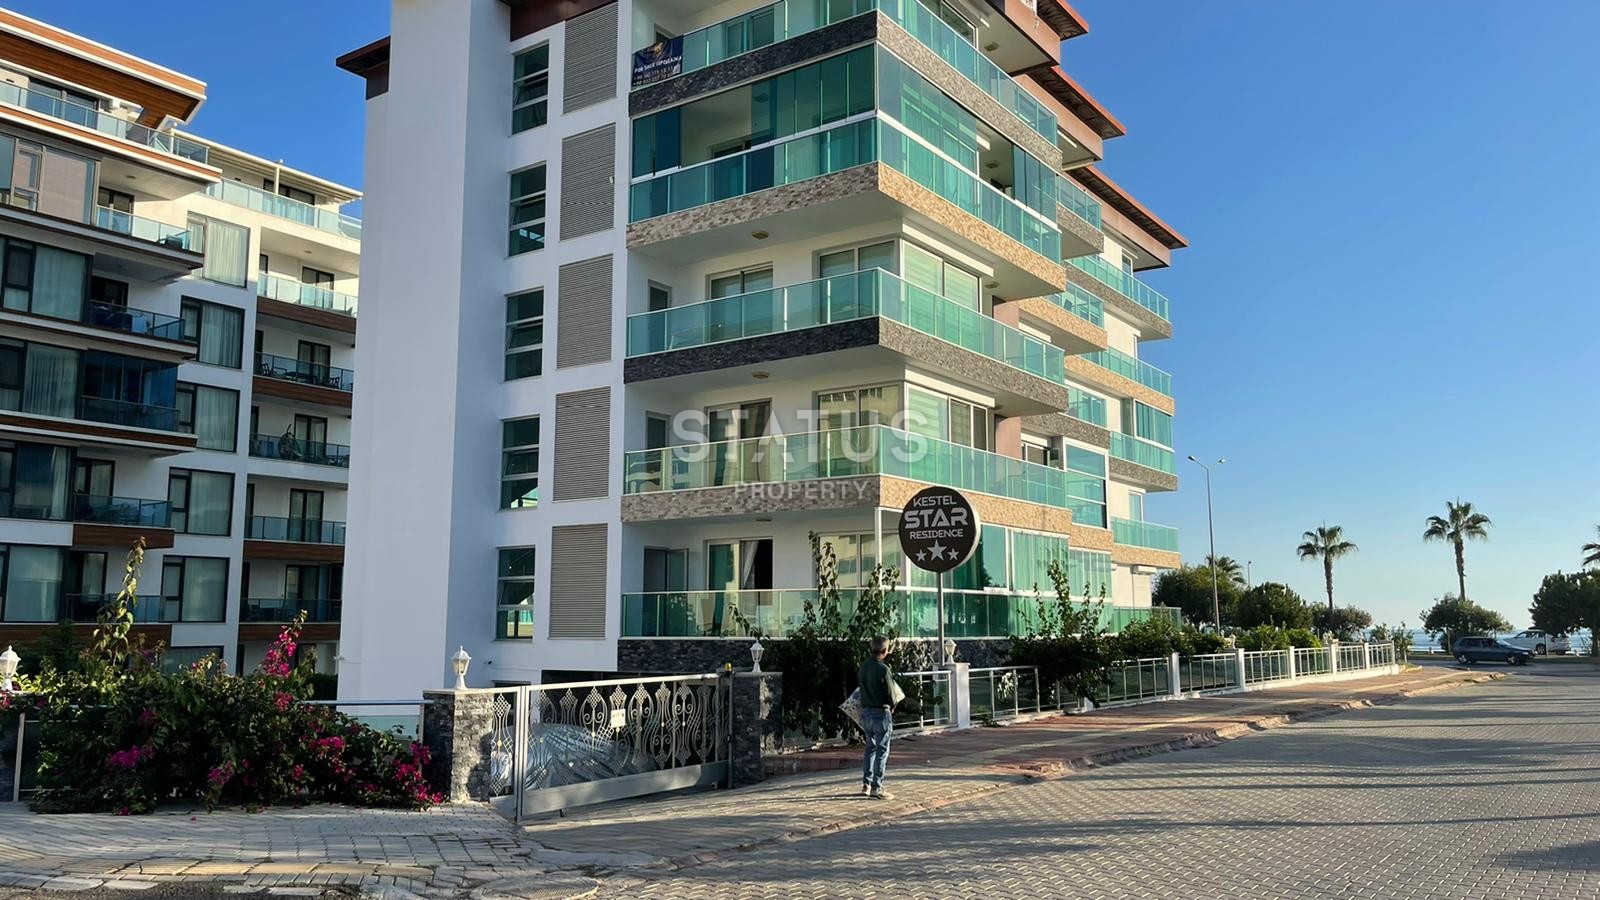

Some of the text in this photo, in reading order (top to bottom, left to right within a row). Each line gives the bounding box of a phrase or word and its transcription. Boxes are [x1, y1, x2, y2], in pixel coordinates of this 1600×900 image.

[913, 495, 957, 507] KESTEL
[904, 507, 968, 529] STAR
[909, 529, 964, 540] RESIDENCE
